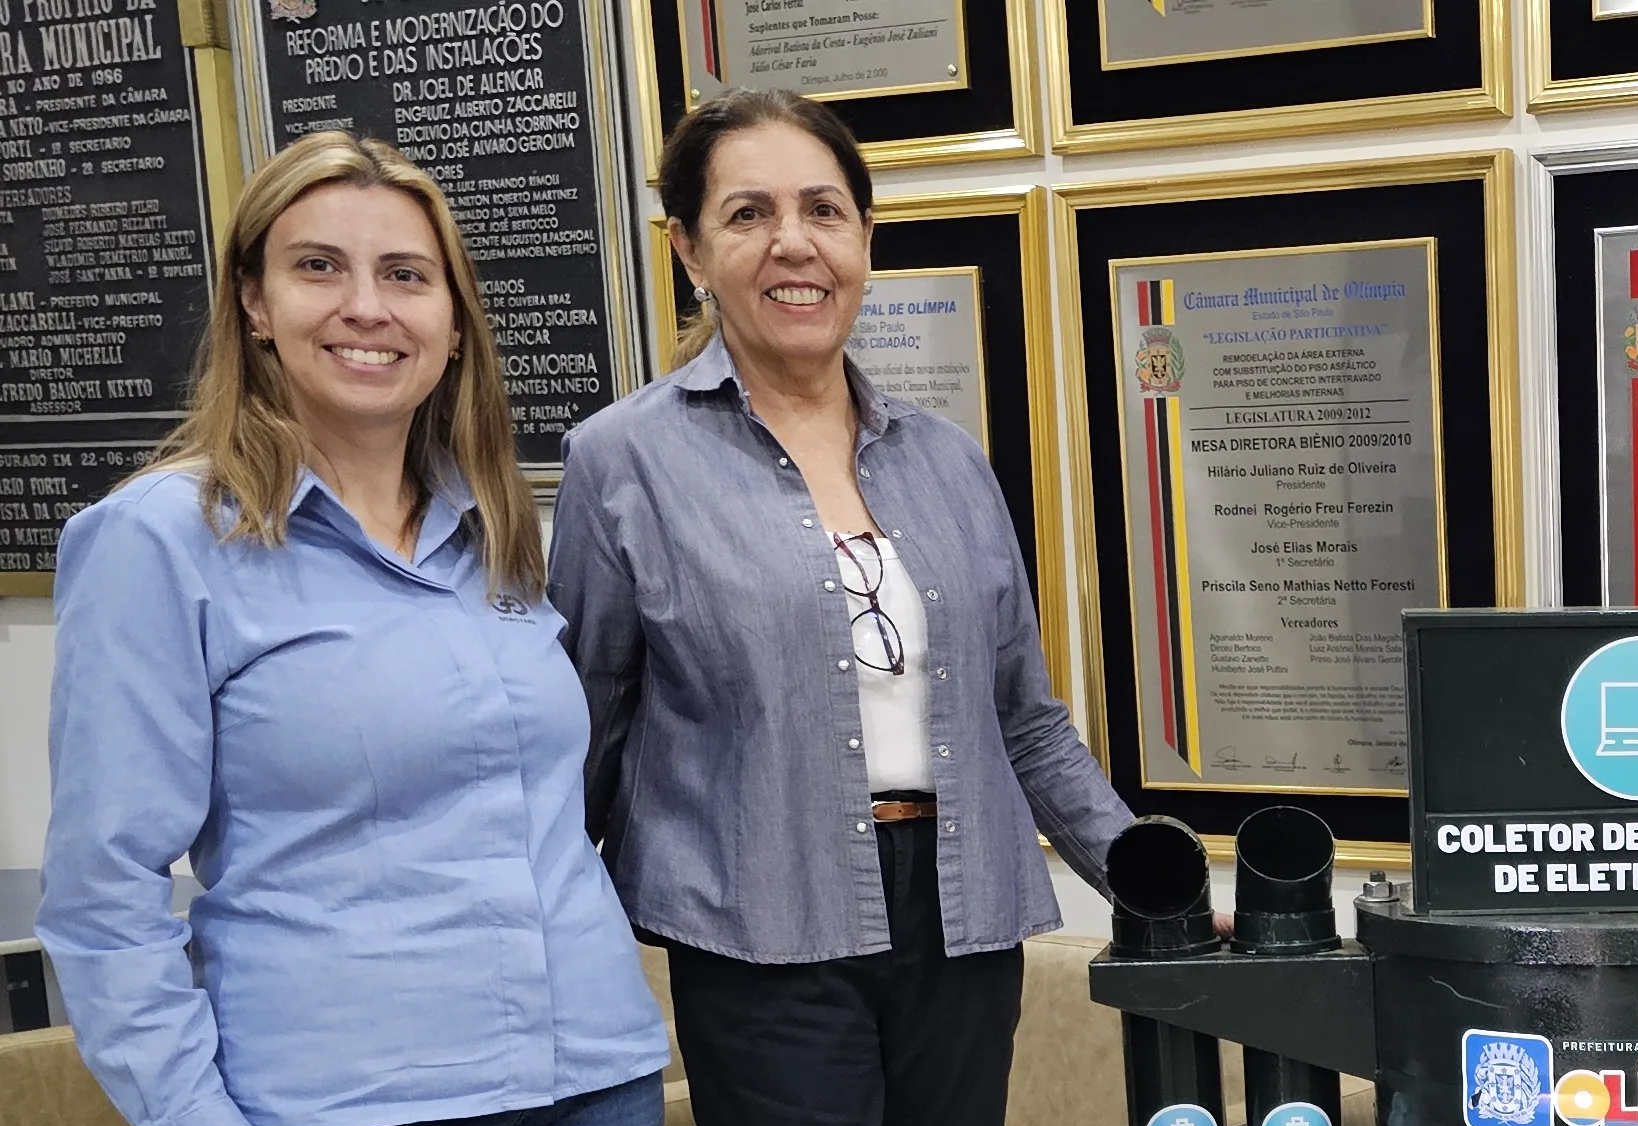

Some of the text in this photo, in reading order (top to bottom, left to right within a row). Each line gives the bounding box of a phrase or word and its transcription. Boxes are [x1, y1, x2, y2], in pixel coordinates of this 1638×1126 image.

[287, 0, 564, 56] REFORMA E MODERNIZAÇÃO DO
[749, 20, 790, 34] Suplentes
[792, 19, 808, 30] que
[809, 13, 850, 27] Tomaram
[39, 14, 161, 70] MUNICIPAL
[306, 31, 542, 84] PRÉDIO E DAS INSTALAÇÕES
[7, 68, 123, 94] NO ANO DE 1986
[393, 67, 543, 102] DR. JOEL DE ALENCAR
[36, 87, 167, 112] PRESIDENTE DA CÂMARA
[454, 91, 576, 118] ALBERTO ZACCARELLI
[51, 293, 162, 309] PREFEITO MUNICIPAL
[1183, 281, 1406, 311] Câmara Municipal de Olímpia
[889, 300, 956, 315] DE OLÍMPIA
[509, 309, 597, 327] DAVID SIQUEIRA
[60, 346, 123, 366] MICHELLI
[534, 353, 597, 375] MOREIRA
[29, 368, 74, 380] DIRETOR
[51, 379, 152, 400] BAIOCHI NETTO
[1225, 408, 1371, 425] LEGISLATURA 2009/2012
[1191, 433, 1411, 453] MESA DIRETORA BIÊNIO 2009/2010
[1208, 462, 1397, 477] Hilário Juliano Ruiz de Oliveira
[1276, 480, 1325, 490] Presidente
[1214, 501, 1393, 517] Rodnei Rogério Freu Ferezin
[1251, 541, 1358, 555] José Elias Morais
[1202, 579, 1415, 593] Priscila Seno Mathias Netto Foresti
[1281, 617, 1338, 628] Vereadores
[1438, 822, 1595, 854] COLETOR
[1494, 863, 1539, 893] DE
